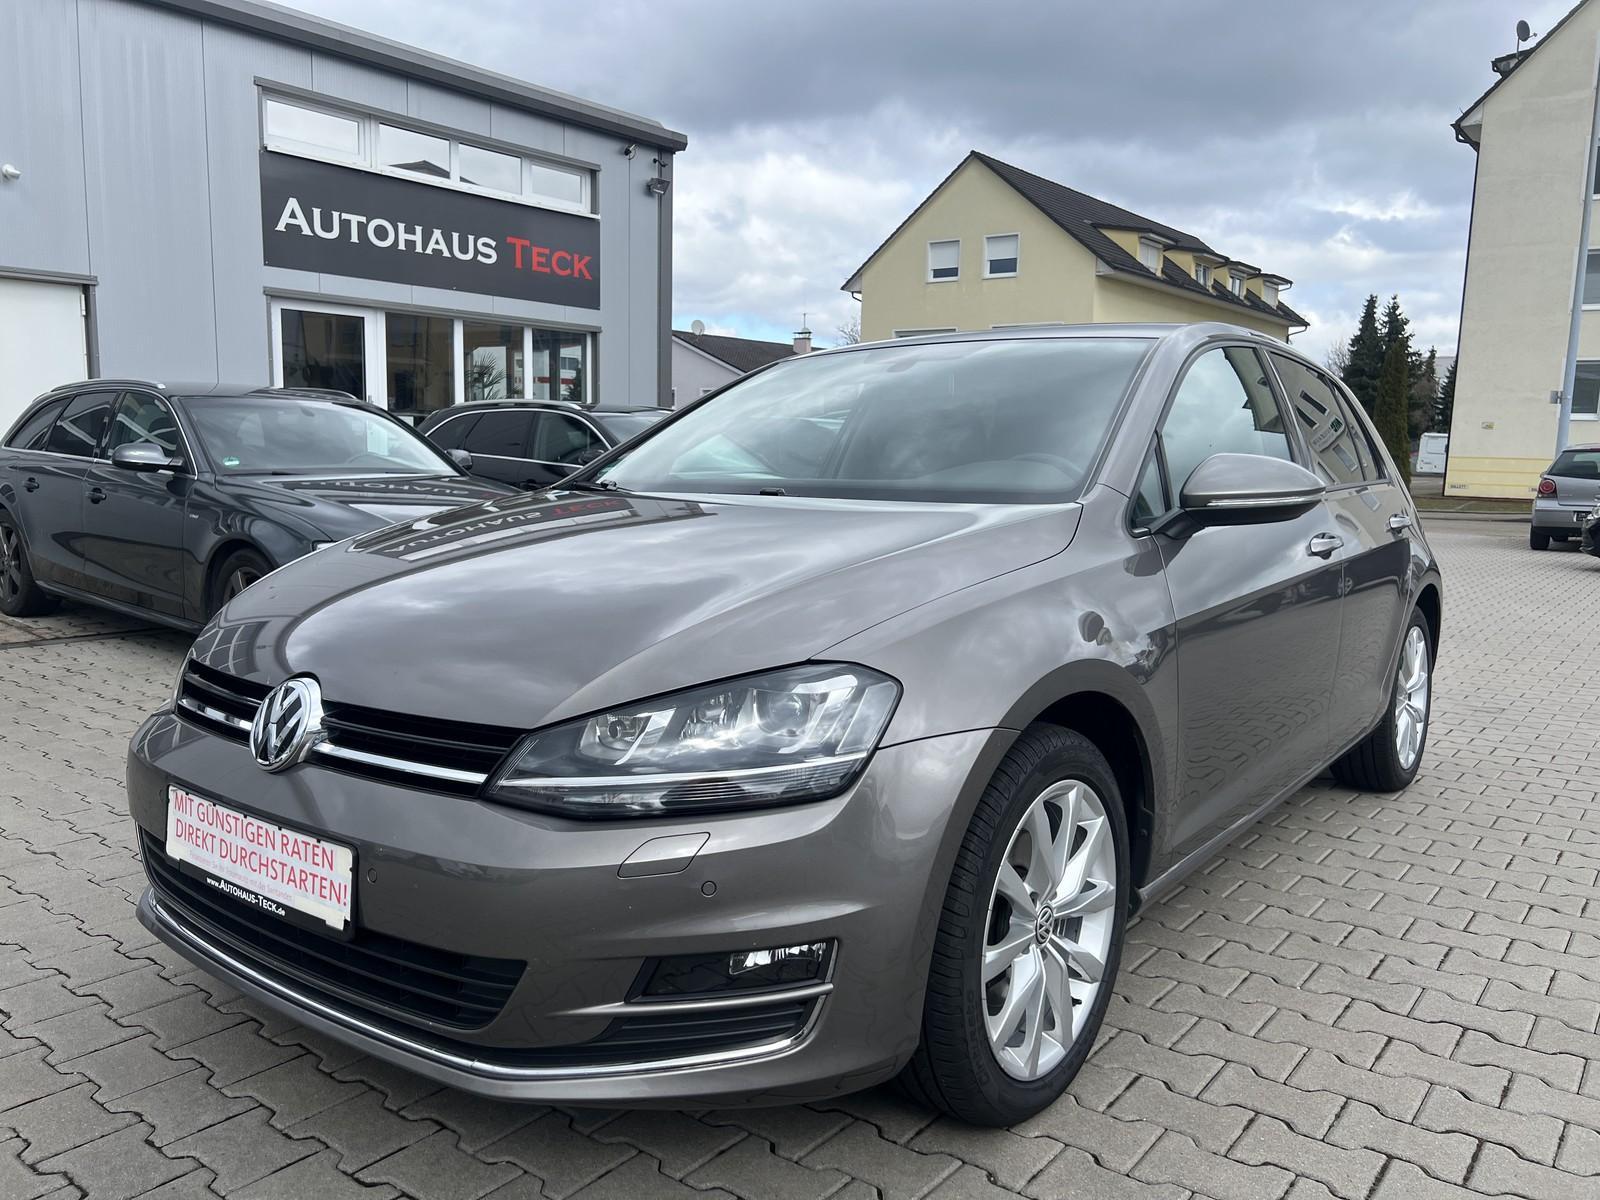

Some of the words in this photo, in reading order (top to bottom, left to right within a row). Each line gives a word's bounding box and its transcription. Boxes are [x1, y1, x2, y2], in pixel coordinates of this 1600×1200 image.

[275, 197, 498, 265] AUTOHAUS
[506, 236, 593, 280] TECK
[174, 791, 194, 816] MIT
[196, 802, 276, 850] GÜNSTIGEN
[281, 833, 334, 872] RATEN
[175, 818, 216, 853] DIREKT
[219, 838, 348, 907] DURCHSTARTEN!
